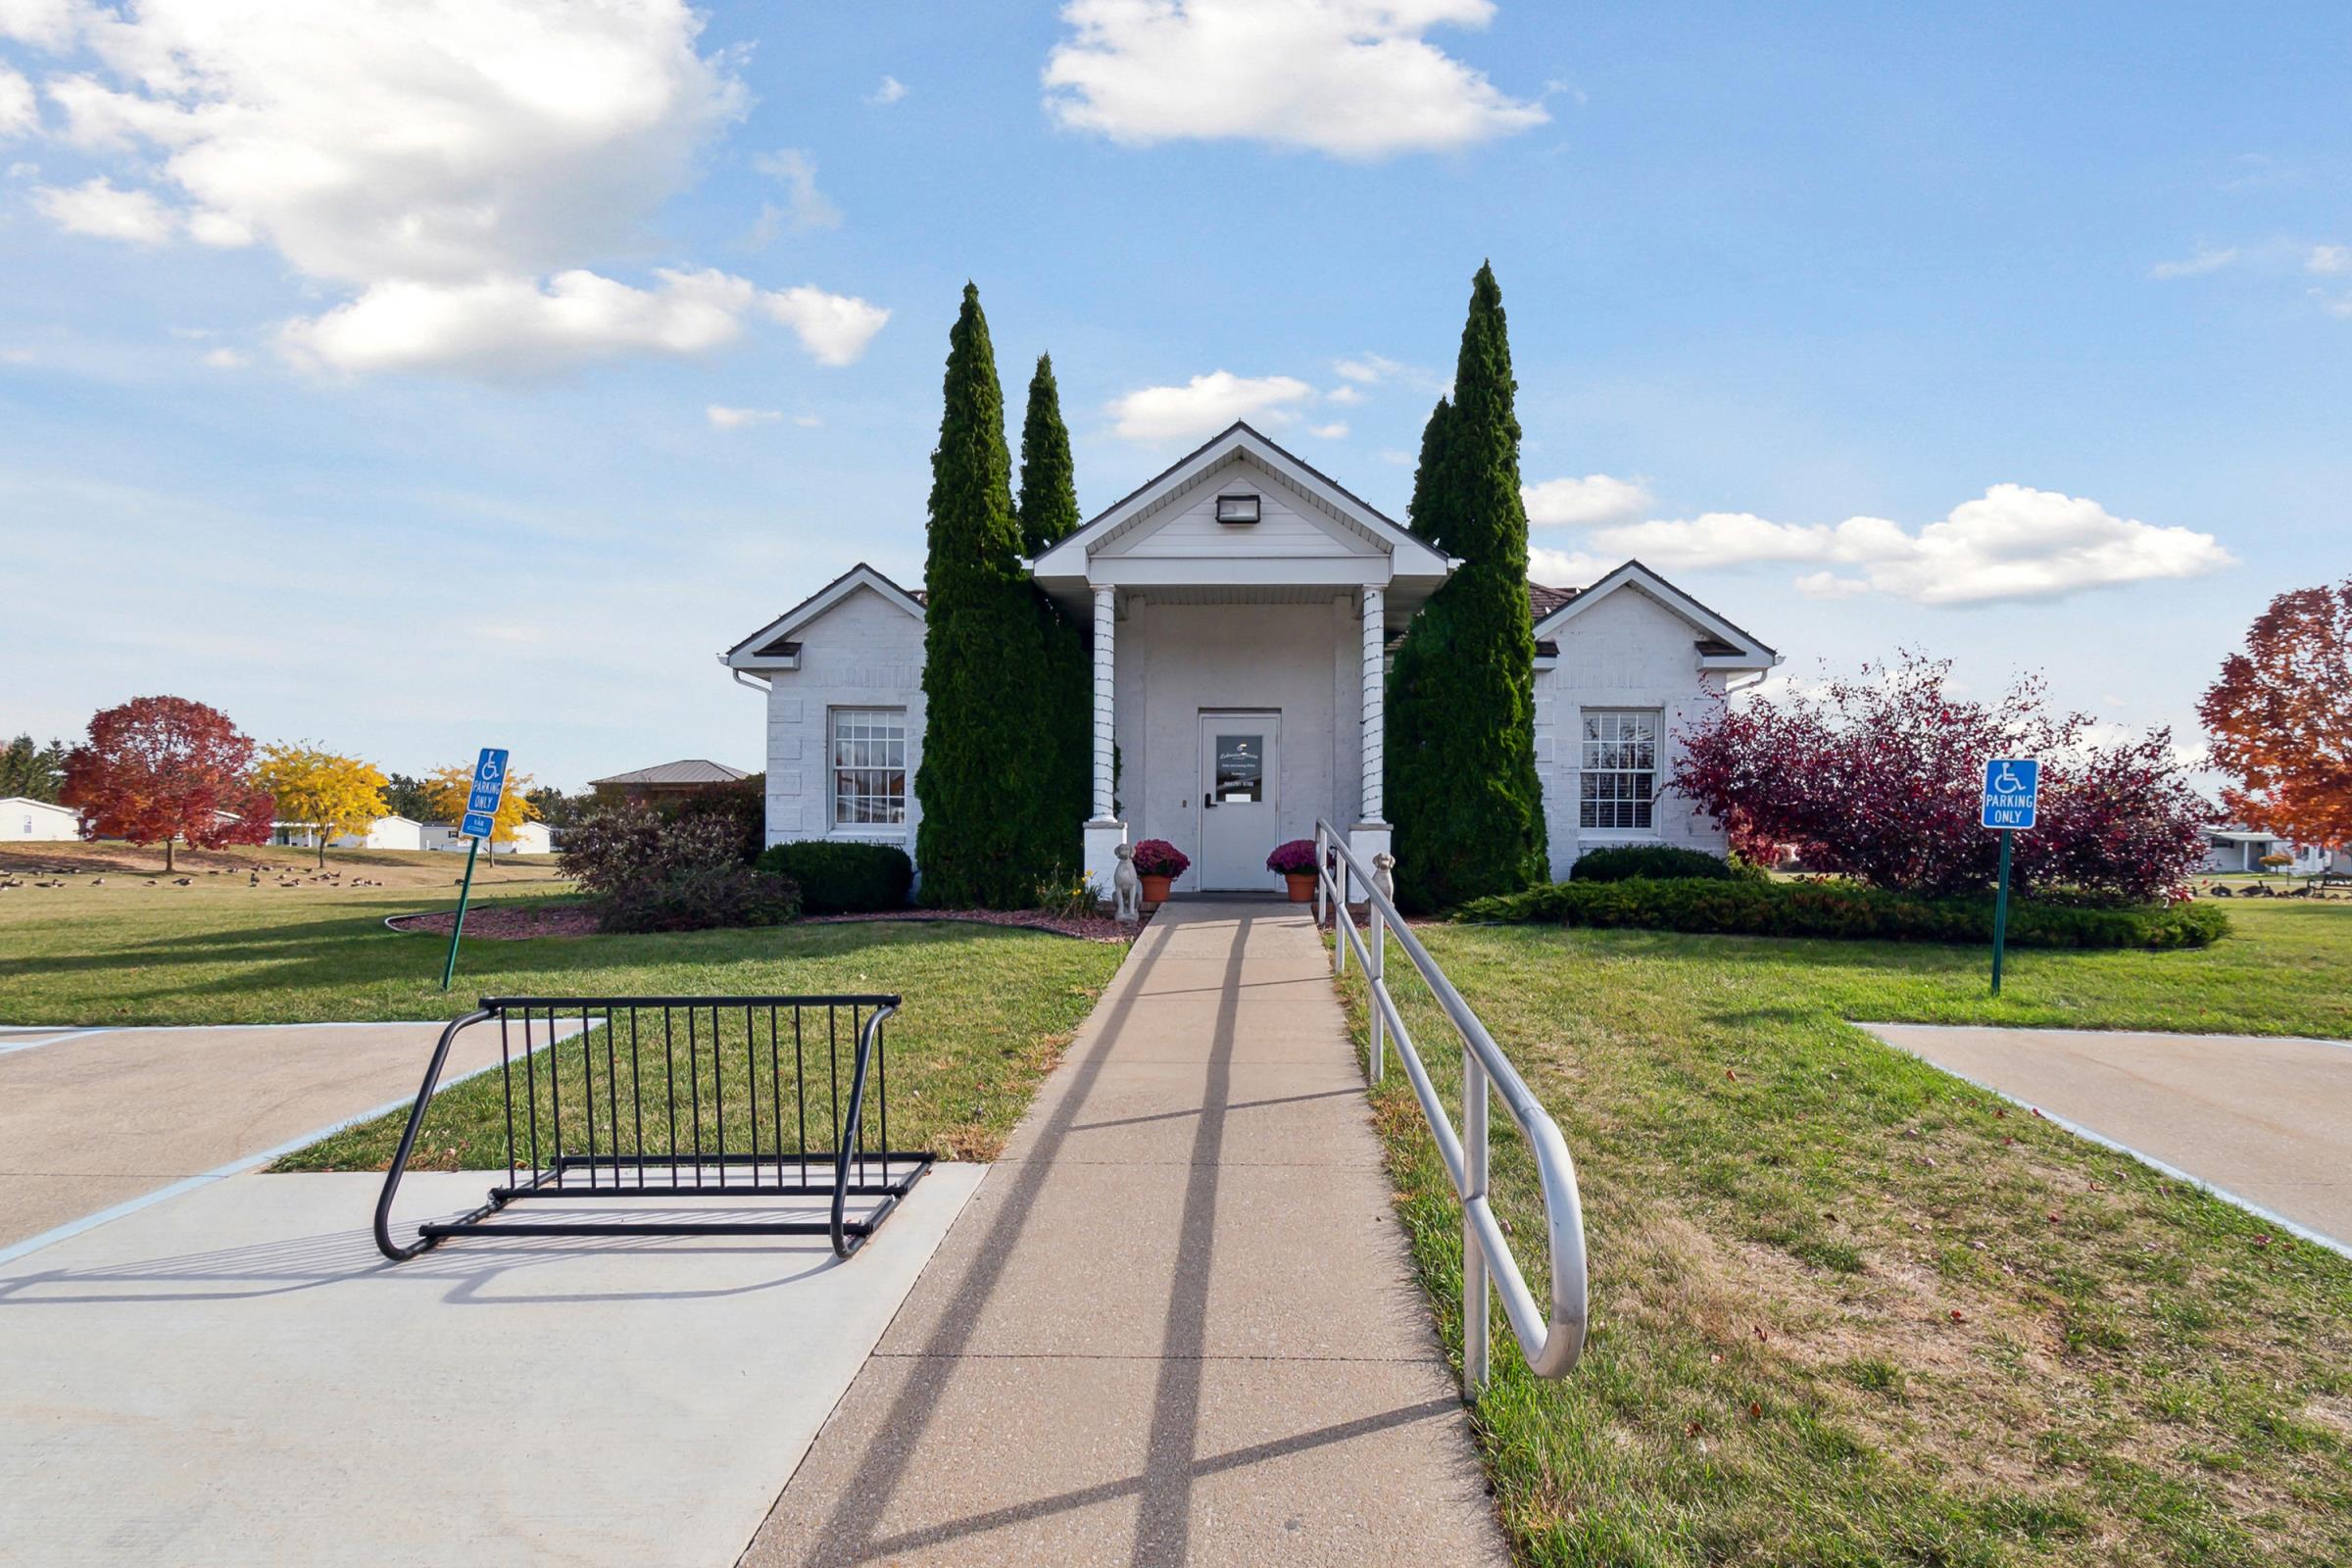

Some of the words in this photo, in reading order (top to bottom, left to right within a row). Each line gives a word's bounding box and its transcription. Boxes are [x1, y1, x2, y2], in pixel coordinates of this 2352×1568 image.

[472, 779, 502, 795] PARKING
[474, 795, 494, 808] ONLY
[1985, 794, 2034, 808] PARKING
[1994, 809, 2023, 823] ONLY
